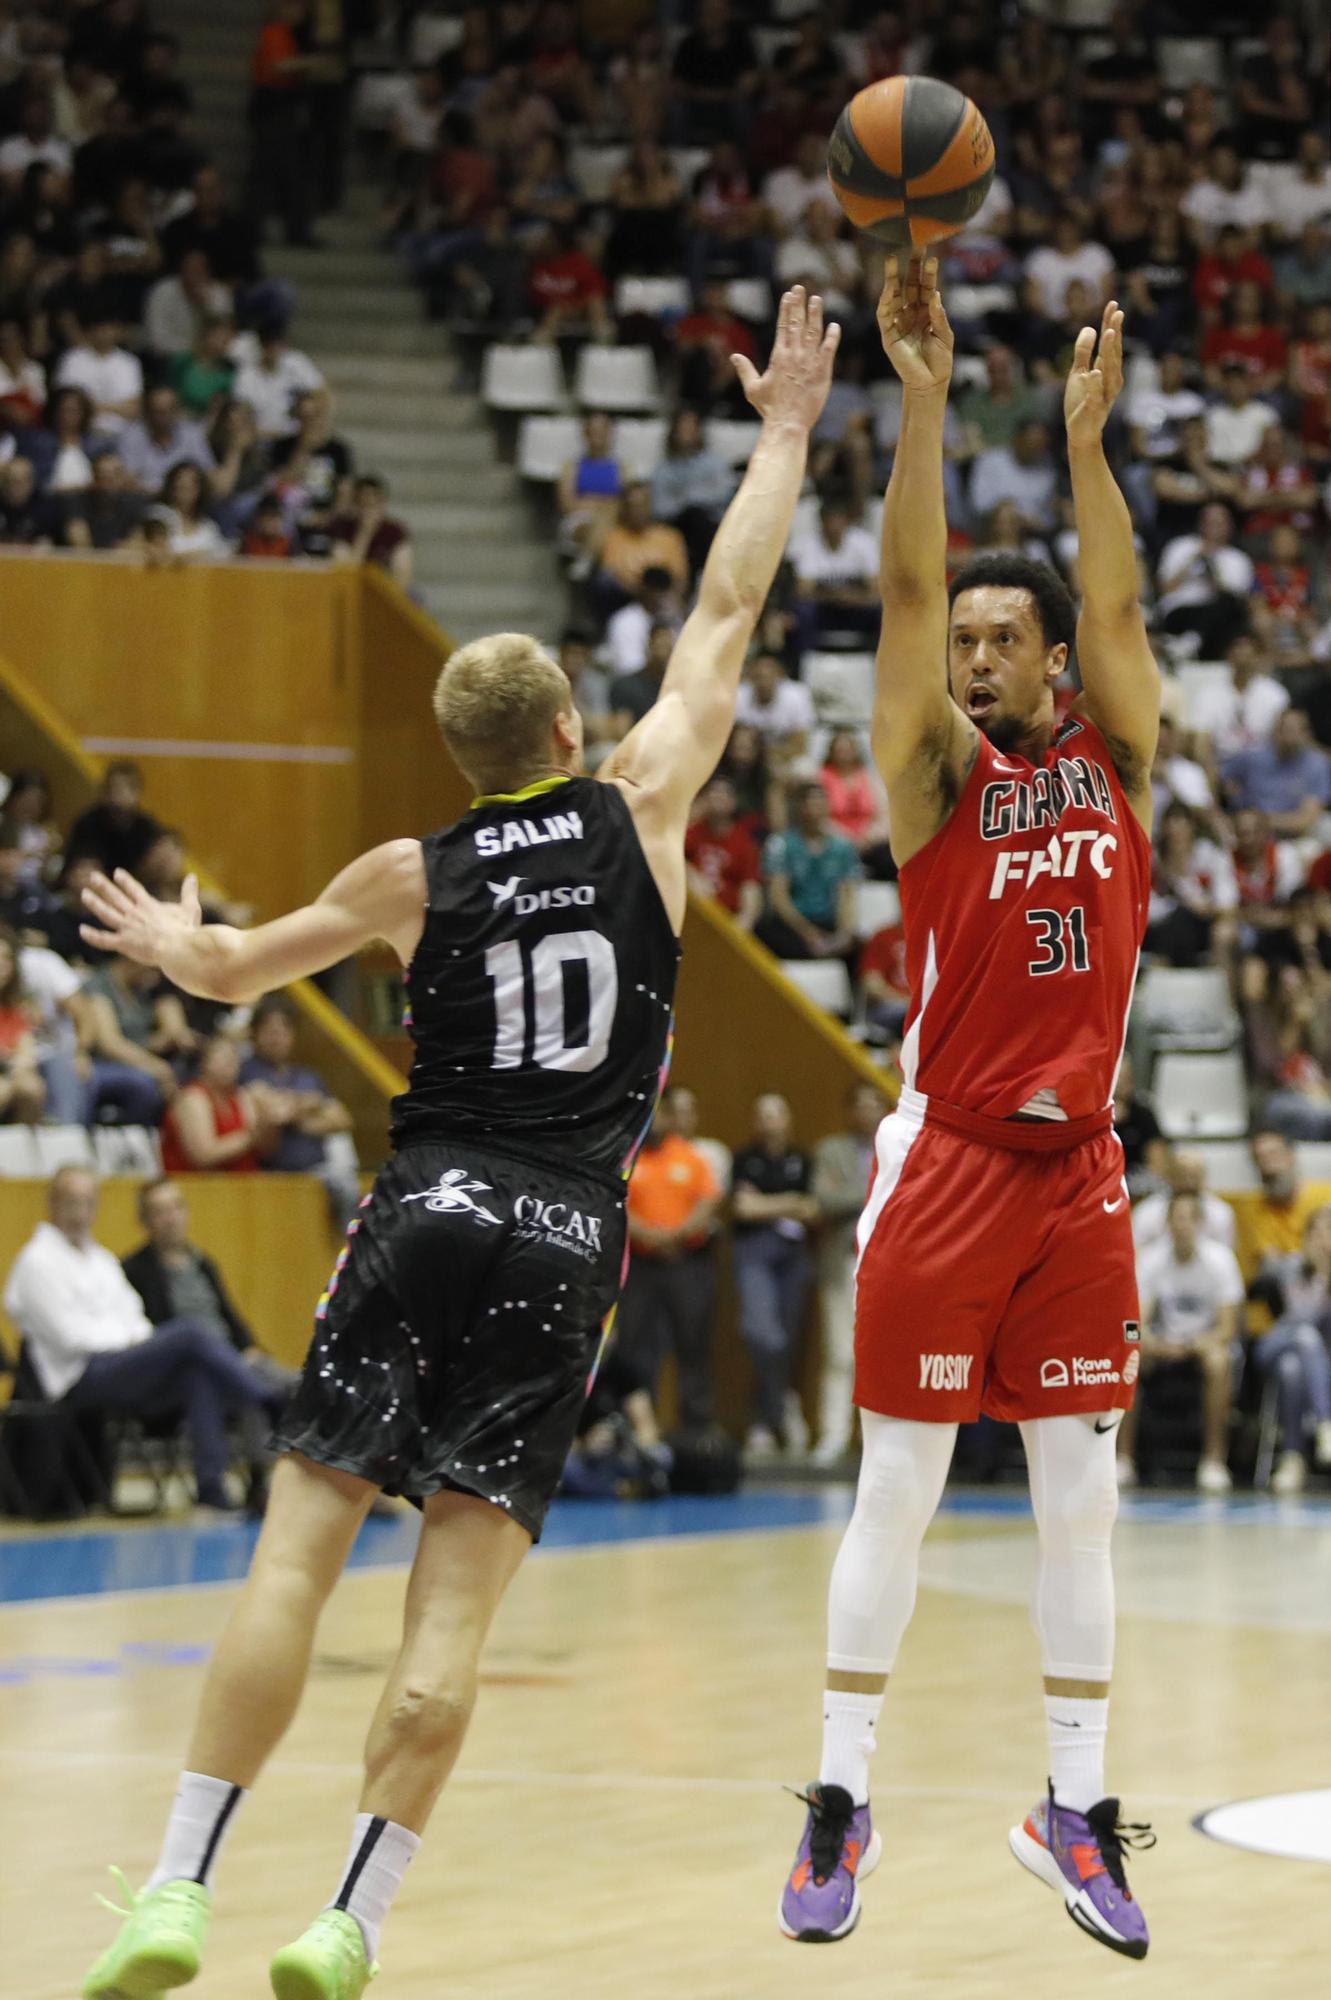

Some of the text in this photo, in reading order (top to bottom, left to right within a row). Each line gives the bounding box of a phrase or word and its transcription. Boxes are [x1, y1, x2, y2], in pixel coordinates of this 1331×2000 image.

[474, 811, 584, 857] SALIN
[1026, 907, 1090, 976] 31
[484, 929, 619, 1073] 10
[919, 1353, 974, 1391] YOSOY
[1072, 1357, 1112, 1370] Kave
[1074, 1370, 1120, 1385] Home
